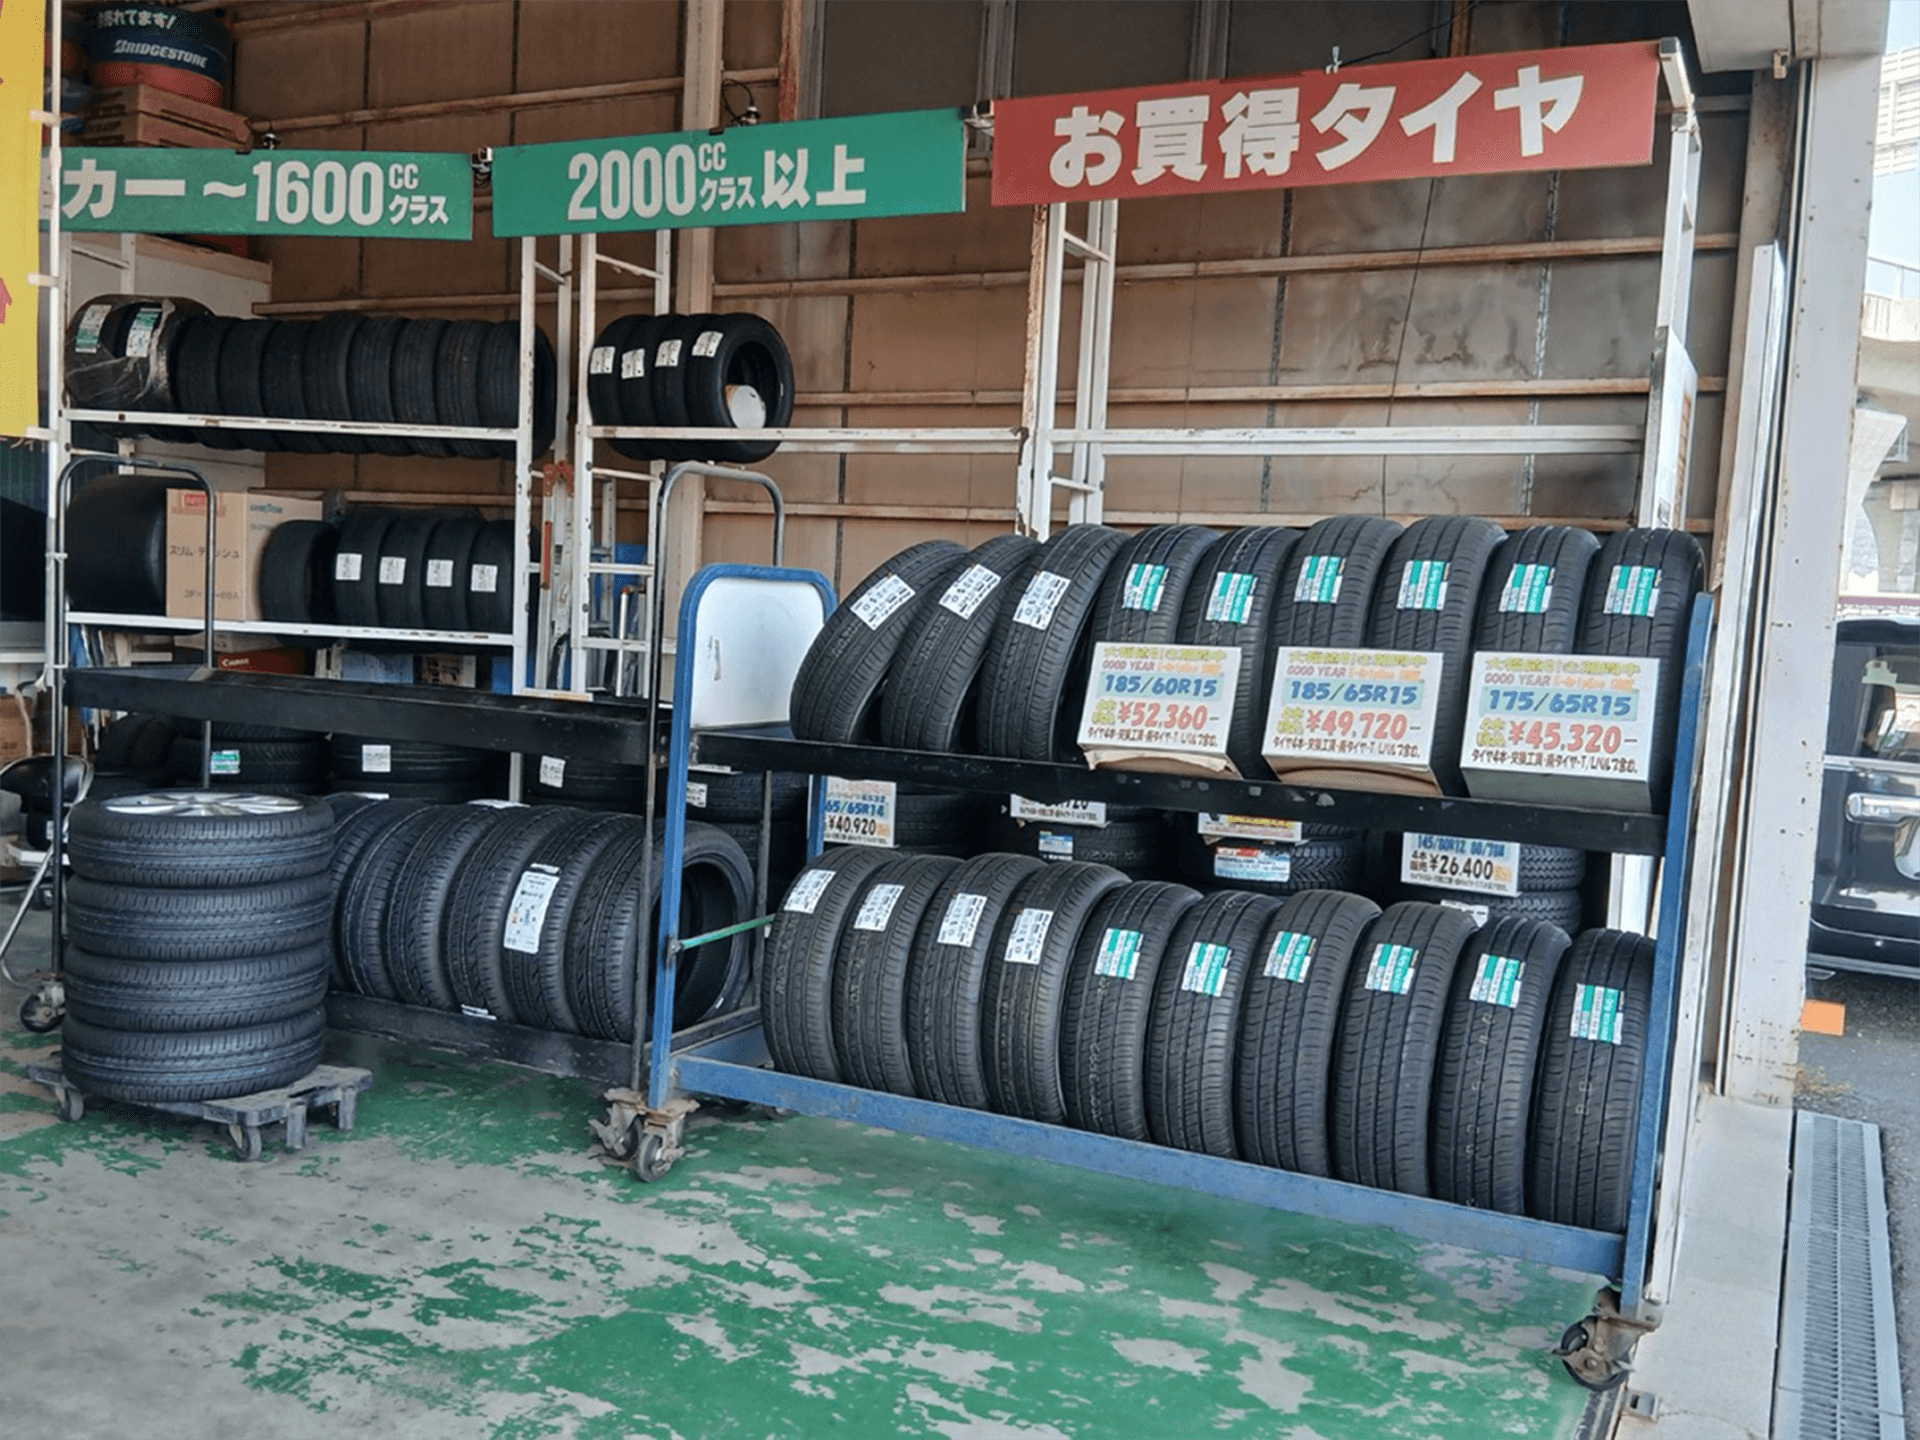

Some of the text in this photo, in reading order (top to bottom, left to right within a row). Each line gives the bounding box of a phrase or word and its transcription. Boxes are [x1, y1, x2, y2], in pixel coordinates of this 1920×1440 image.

[113, 39, 208, 69] BRIDGESTONE
[1048, 65, 1585, 190] お買得タイヤ
[567, 143, 697, 222] 2000
[761, 144, 867, 210] 以上
[700, 176, 756, 213] クラス
[388, 195, 449, 226] クラス
[1105, 674, 1218, 697] 185/60R15
[1318, 666, 1347, 677] YEAR
[1484, 673, 1514, 684] GOOD
[1518, 674, 1551, 685] YEAR
[1291, 680, 1418, 705] 185/65R15
[1489, 689, 1632, 716] 175/65R15
